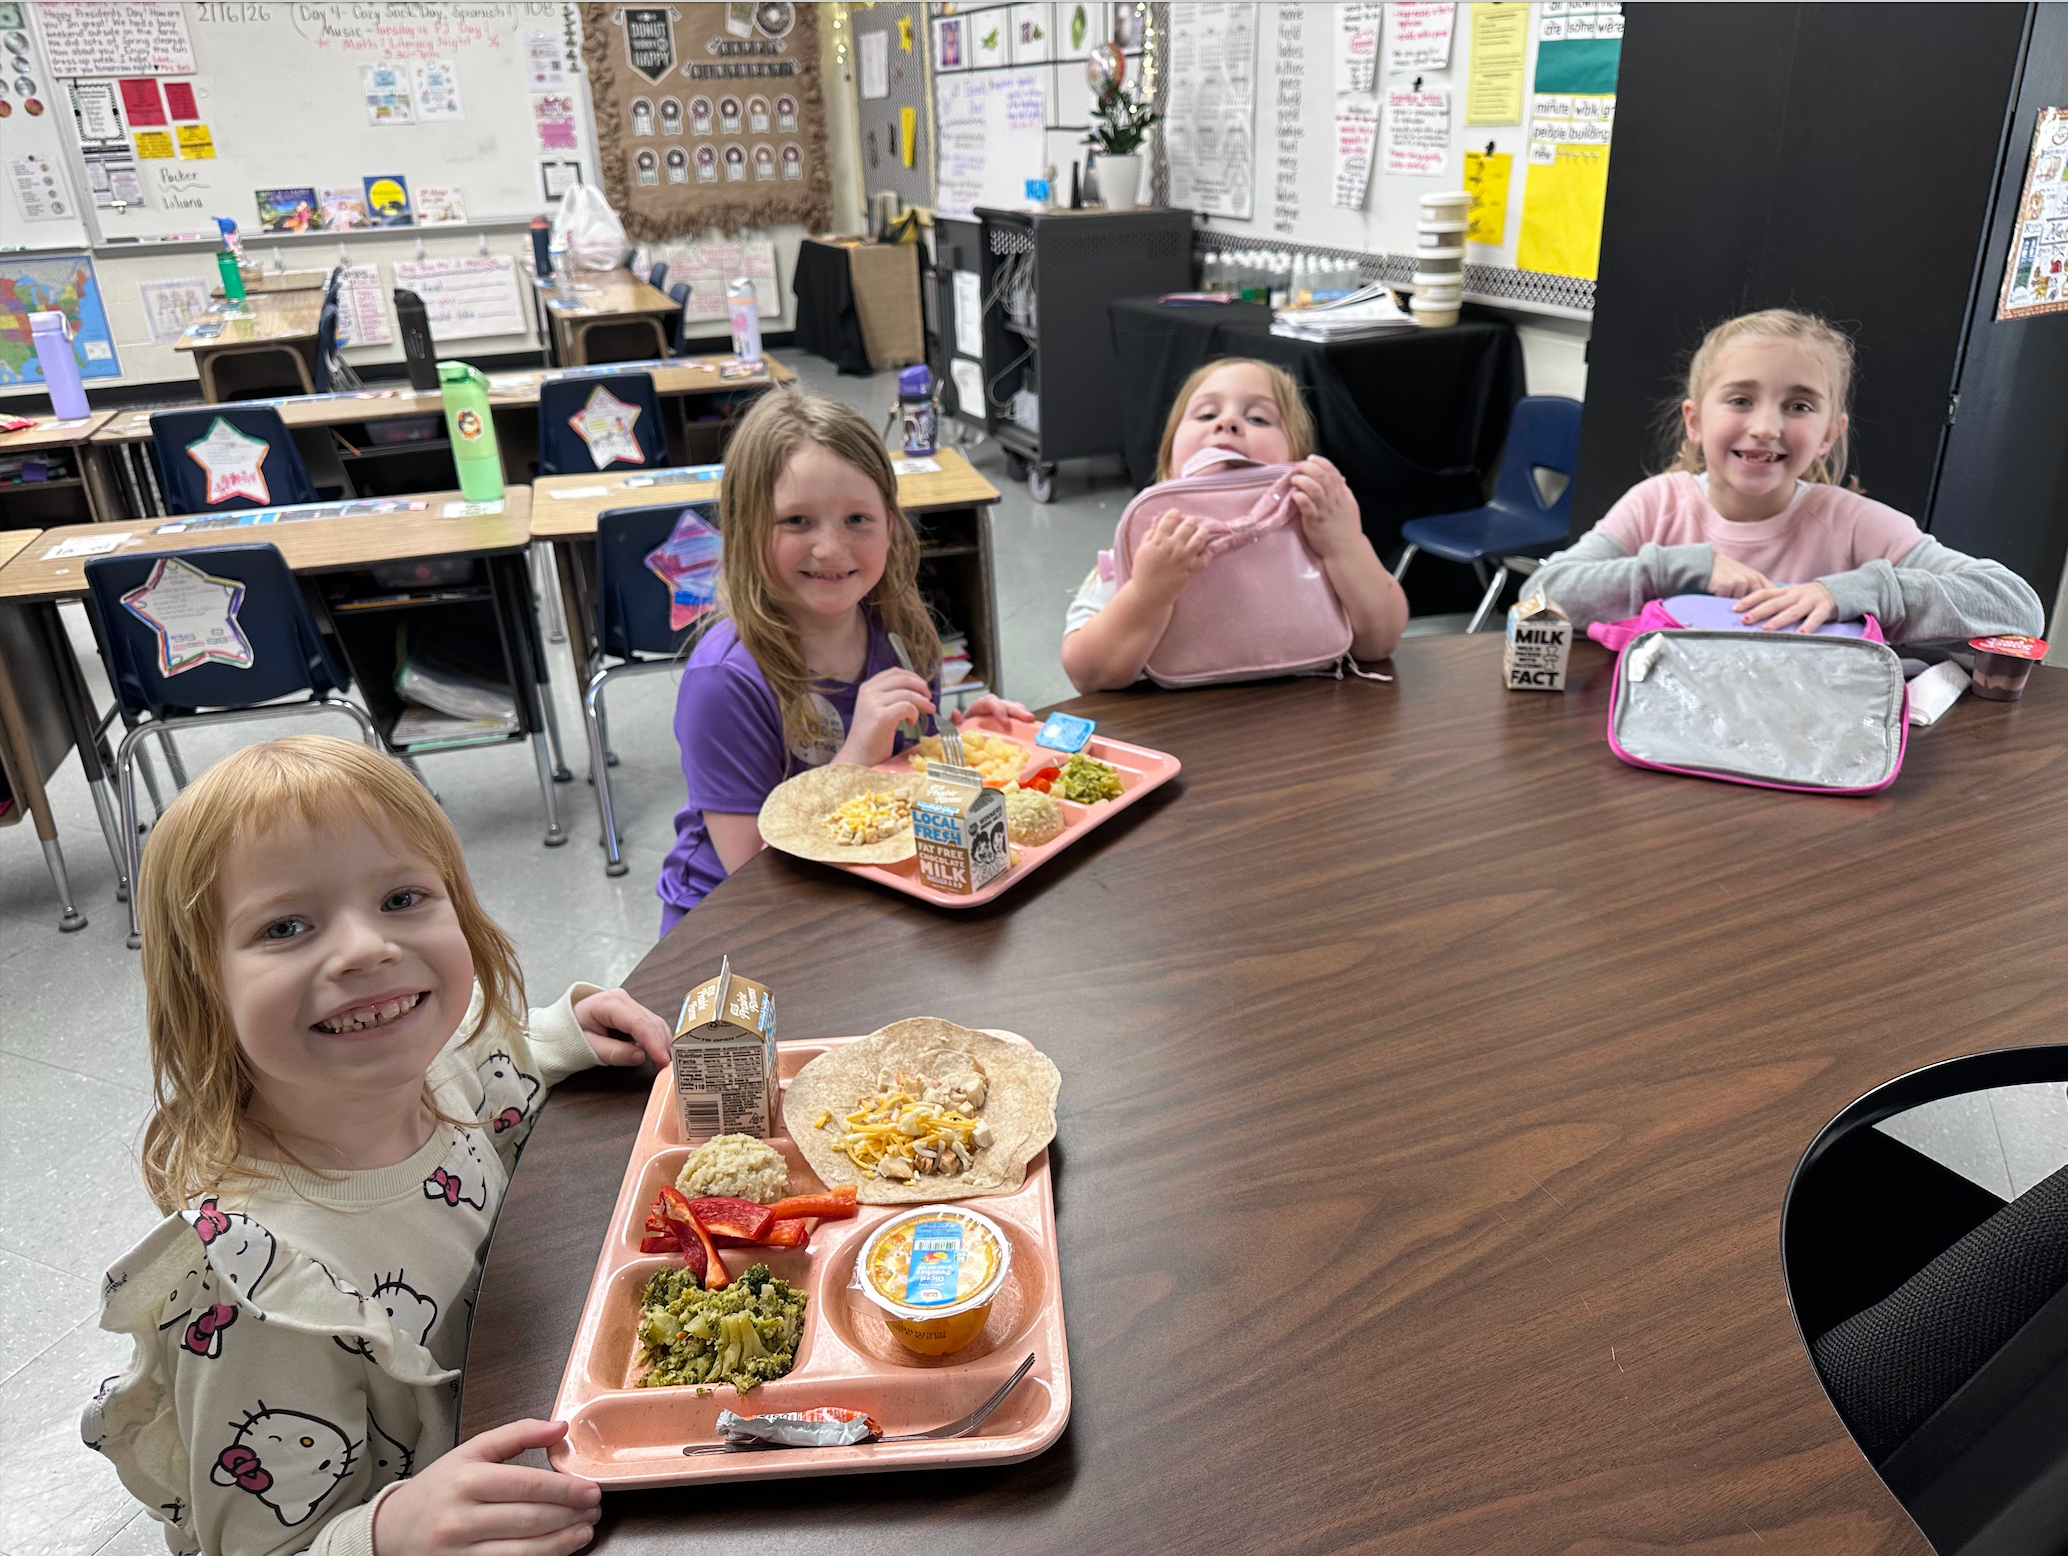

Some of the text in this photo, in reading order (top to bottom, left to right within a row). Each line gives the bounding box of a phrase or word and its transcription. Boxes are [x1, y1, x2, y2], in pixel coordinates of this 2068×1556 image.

[44, 9, 71, 20] Happy
[322, 25, 363, 37] Music
[631, 22, 667, 38] DONUT
[1544, 21, 1625, 36] are some were
[343, 37, 377, 49] Math
[634, 51, 671, 67] HAPPY
[1536, 101, 1570, 115] minute
[1533, 126, 1610, 143] people building
[1534, 149, 1553, 160] new
[1515, 629, 1565, 646] MILK
[1511, 670, 1560, 687] FACT
[912, 810, 960, 831] LOCAL
[914, 823, 962, 846] FRESH
[918, 842, 965, 860] FAT FREE
[919, 852, 965, 868] CHOCOLATE
[920, 859, 967, 884] MILK
